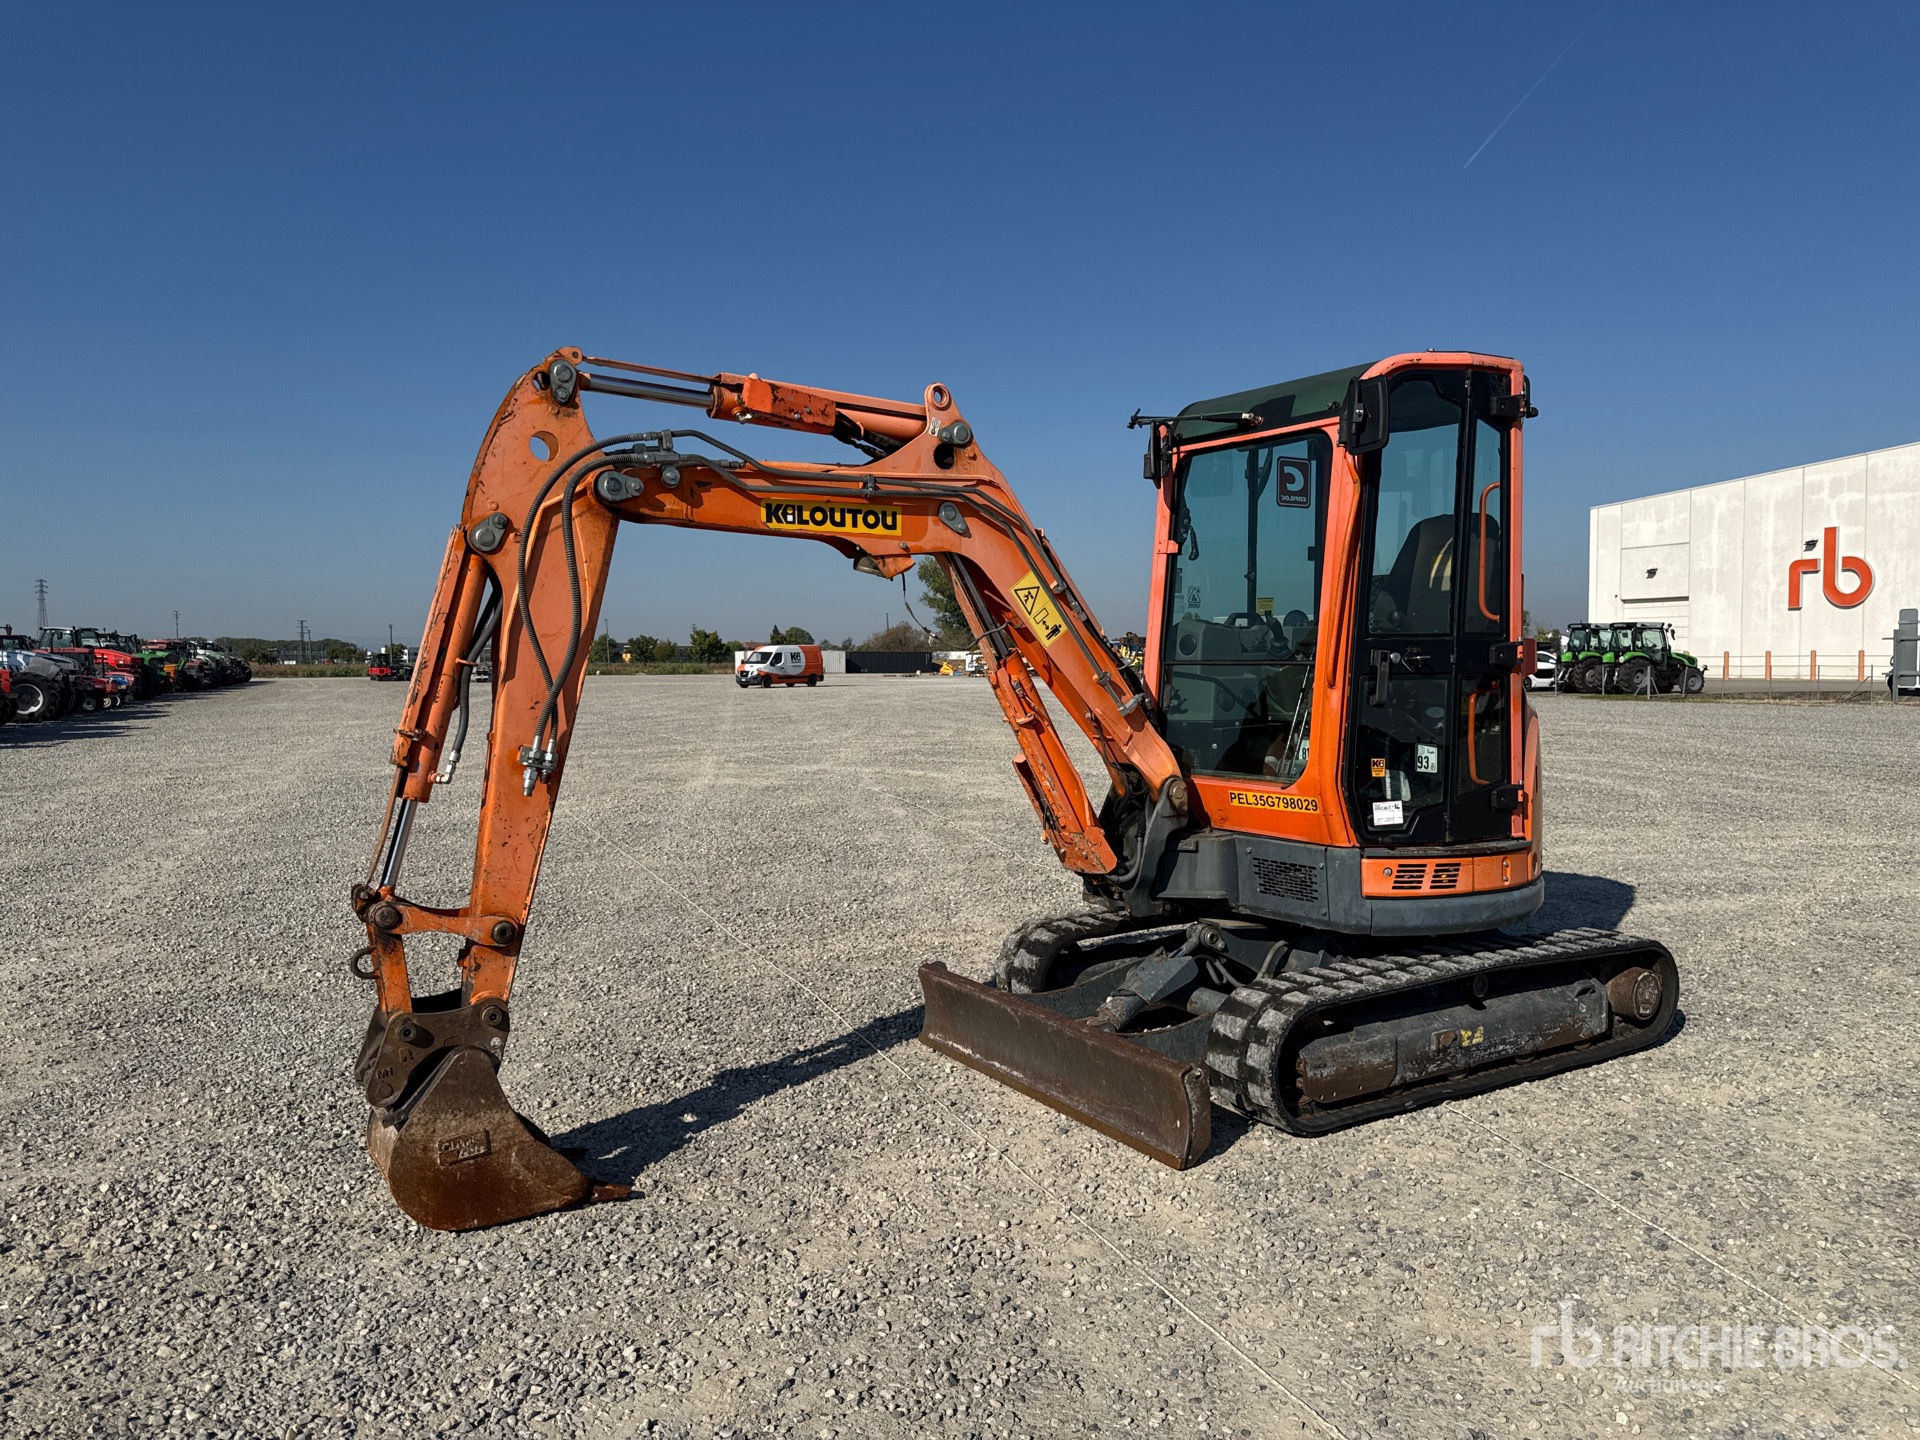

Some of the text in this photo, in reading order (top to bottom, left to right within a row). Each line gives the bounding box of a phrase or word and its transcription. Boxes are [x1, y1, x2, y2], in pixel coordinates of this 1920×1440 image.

[1788, 526, 1875, 611] rb
[1417, 755, 1429, 770] 93
[1229, 792, 1318, 812] PEL35G798029
